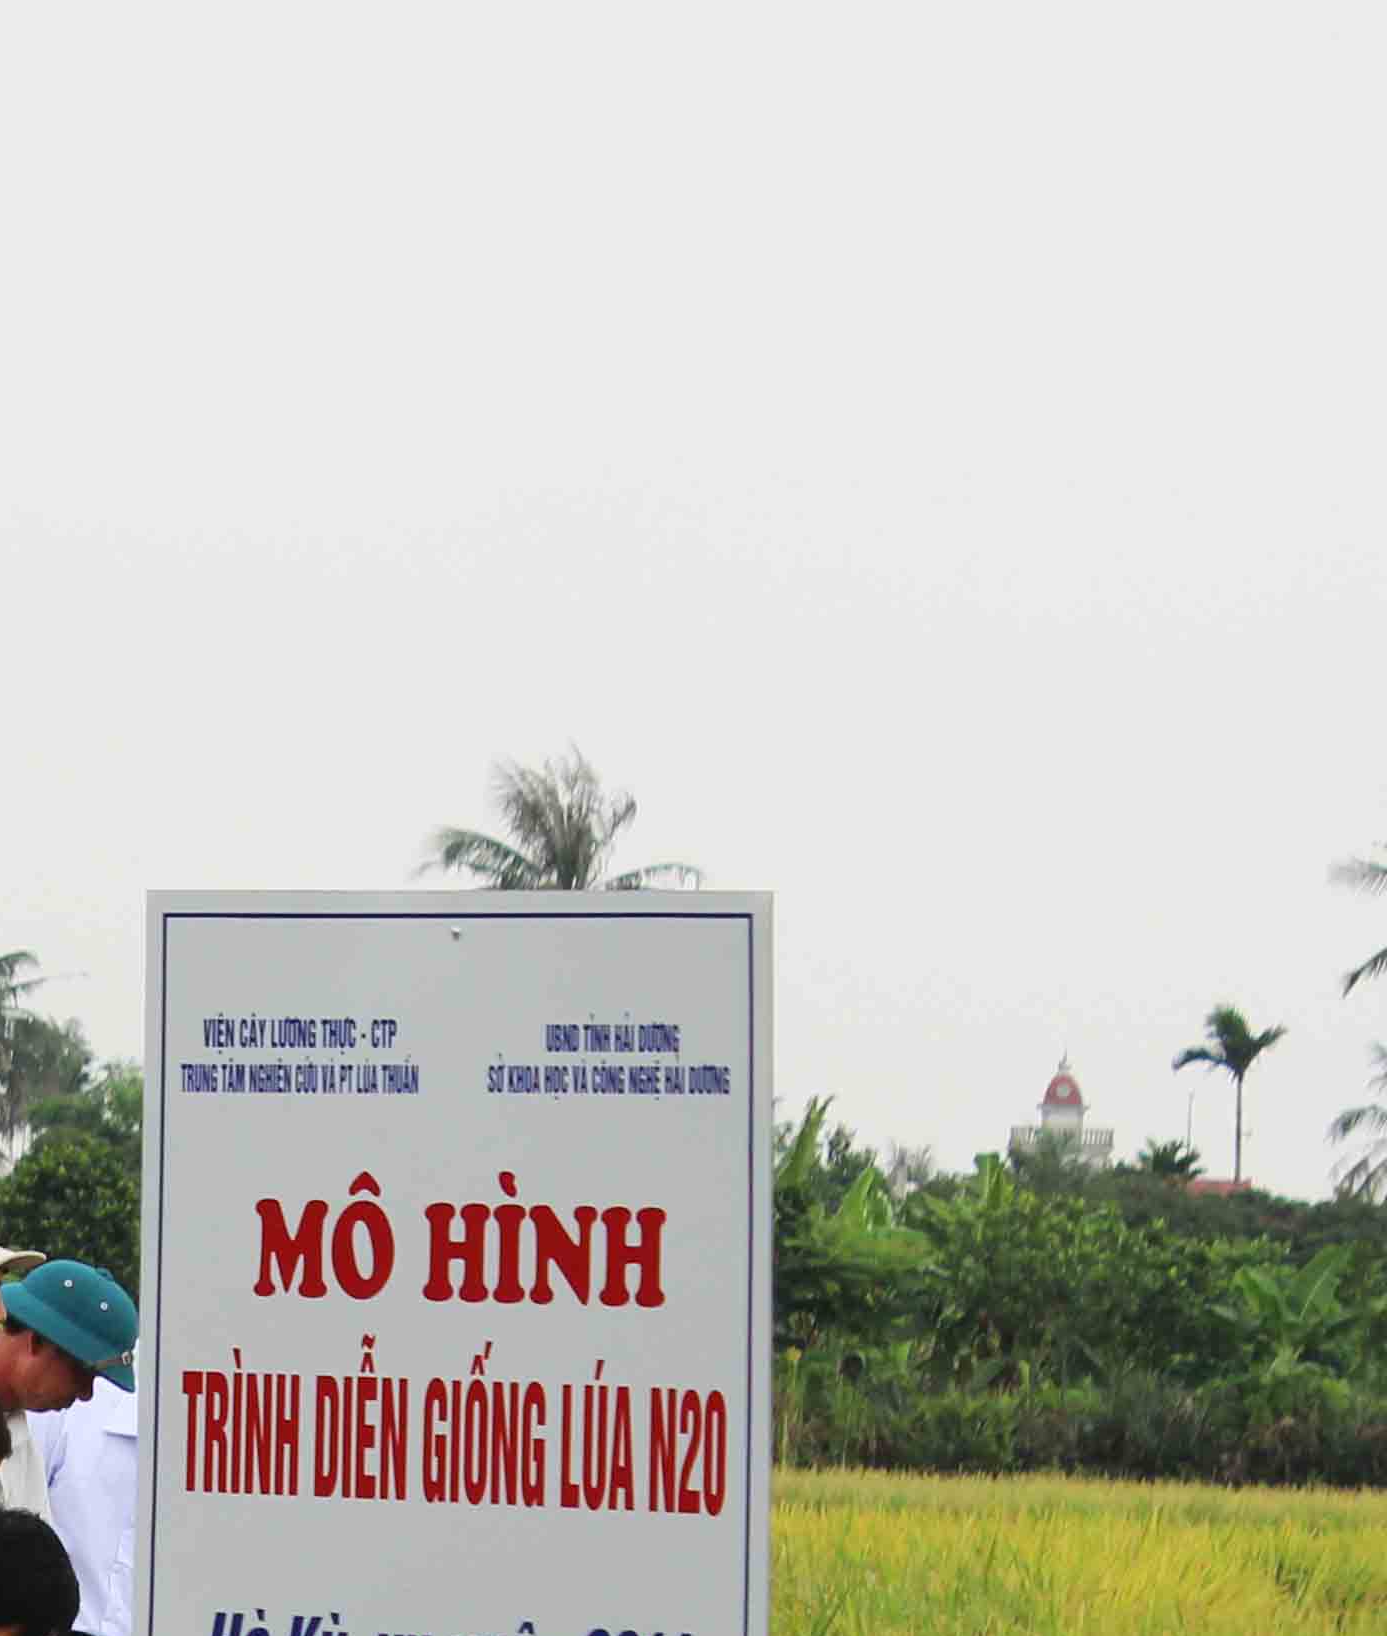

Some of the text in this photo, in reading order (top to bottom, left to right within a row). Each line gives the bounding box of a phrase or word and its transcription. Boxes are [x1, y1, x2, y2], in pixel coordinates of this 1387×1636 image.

[203, 1013, 235, 1054] VIỆN
[239, 1013, 267, 1048] CÂY
[271, 1016, 317, 1048] LƯƠNG
[321, 1016, 357, 1055] THỰC
[371, 1019, 397, 1048] CTP
[181, 1064, 218, 1093] TRUNG
[222, 1057, 245, 1093] TÂM
[249, 1057, 291, 1093] NGHIÊN
[321, 1058, 336, 1093] VÀ
[339, 1064, 353, 1093] PT
[356, 1058, 378, 1093] LÚA
[507, 1066, 540, 1093] KHOA
[571, 1059, 588, 1093] VÀ
[592, 1060, 625, 1094] CÔNG
[254, 1171, 667, 1308] MÔ HÌNH
[182, 1334, 726, 1518] TRÌNH DIỄN GIỐNG LÚA N20
